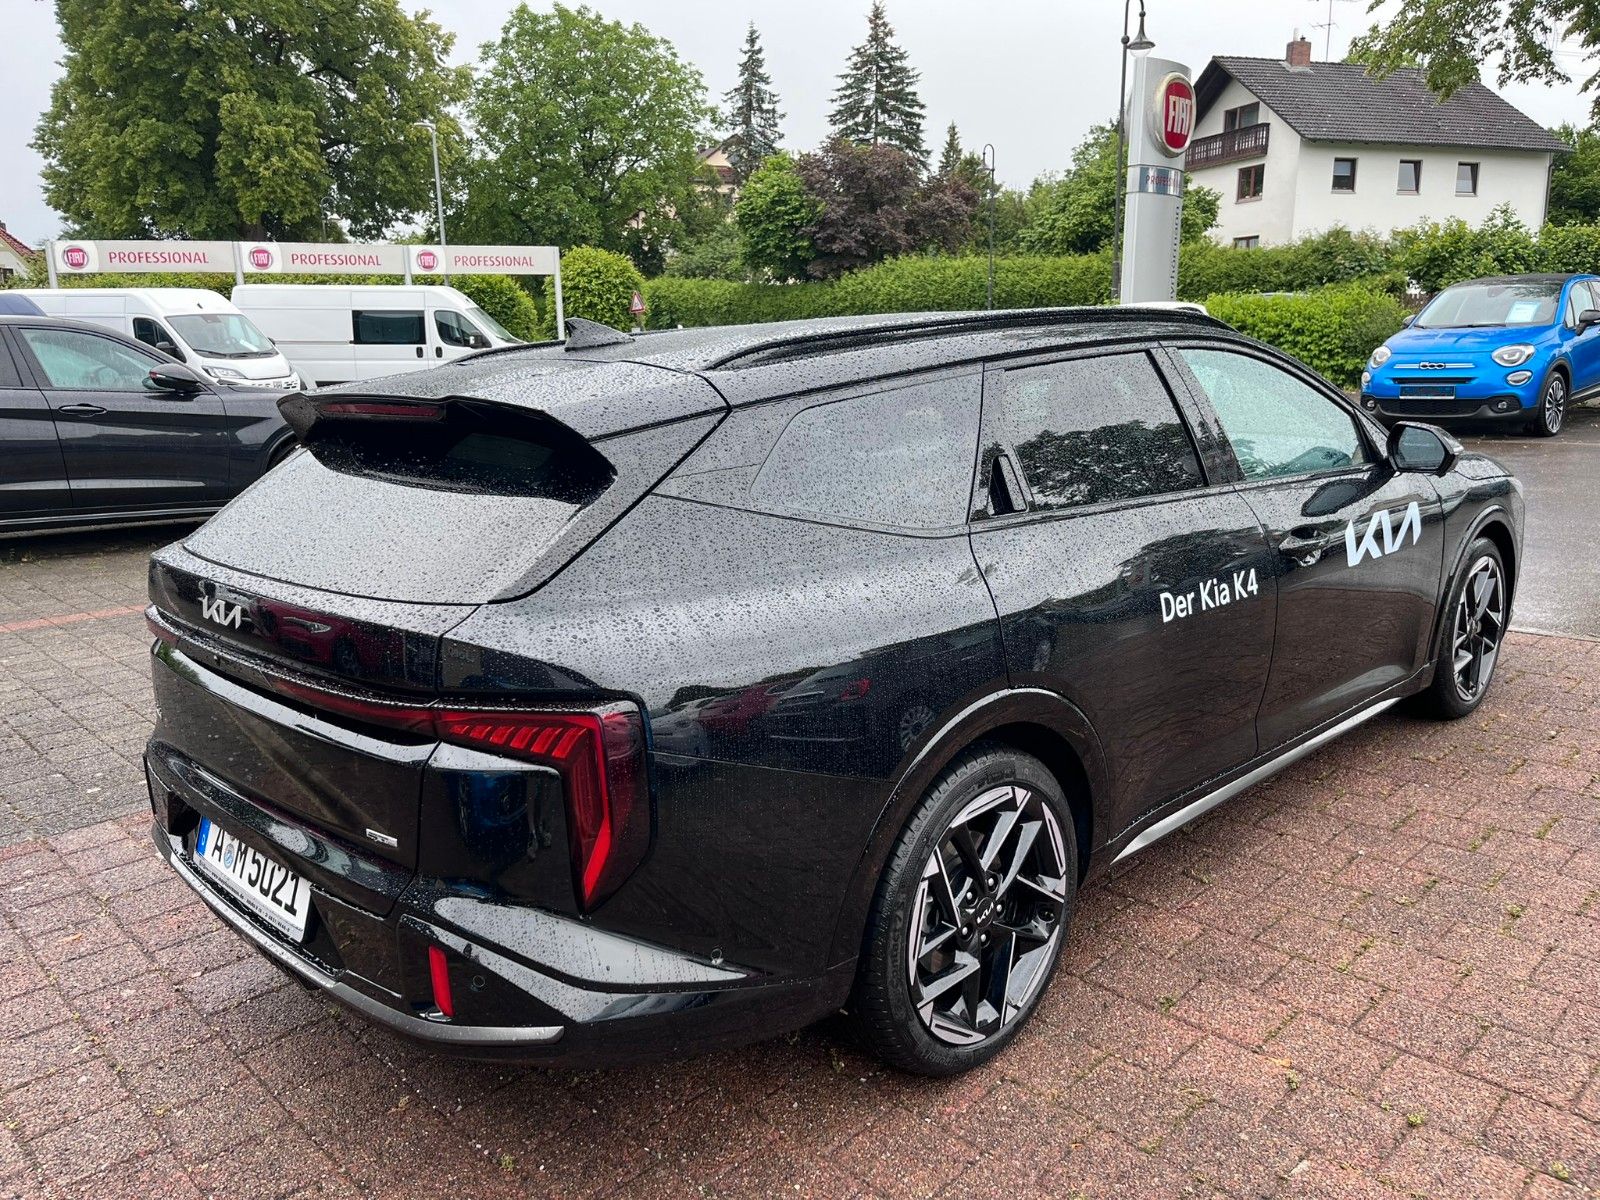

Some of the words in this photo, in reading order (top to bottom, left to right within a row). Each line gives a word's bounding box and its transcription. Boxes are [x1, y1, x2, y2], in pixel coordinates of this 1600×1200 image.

[1167, 95, 1191, 135] FIAT
[67, 251, 84, 266] FIAT
[108, 251, 209, 264] PROFESSIONAL
[253, 252, 269, 265] FIAT
[291, 253, 382, 266] PROFESSIONAL
[454, 255, 534, 267] PROFESSIONAL
[1420, 361, 1445, 370] 500
[1159, 590, 1194, 623] Der
[1199, 578, 1230, 611] Kia
[1233, 568, 1258, 601] K4
